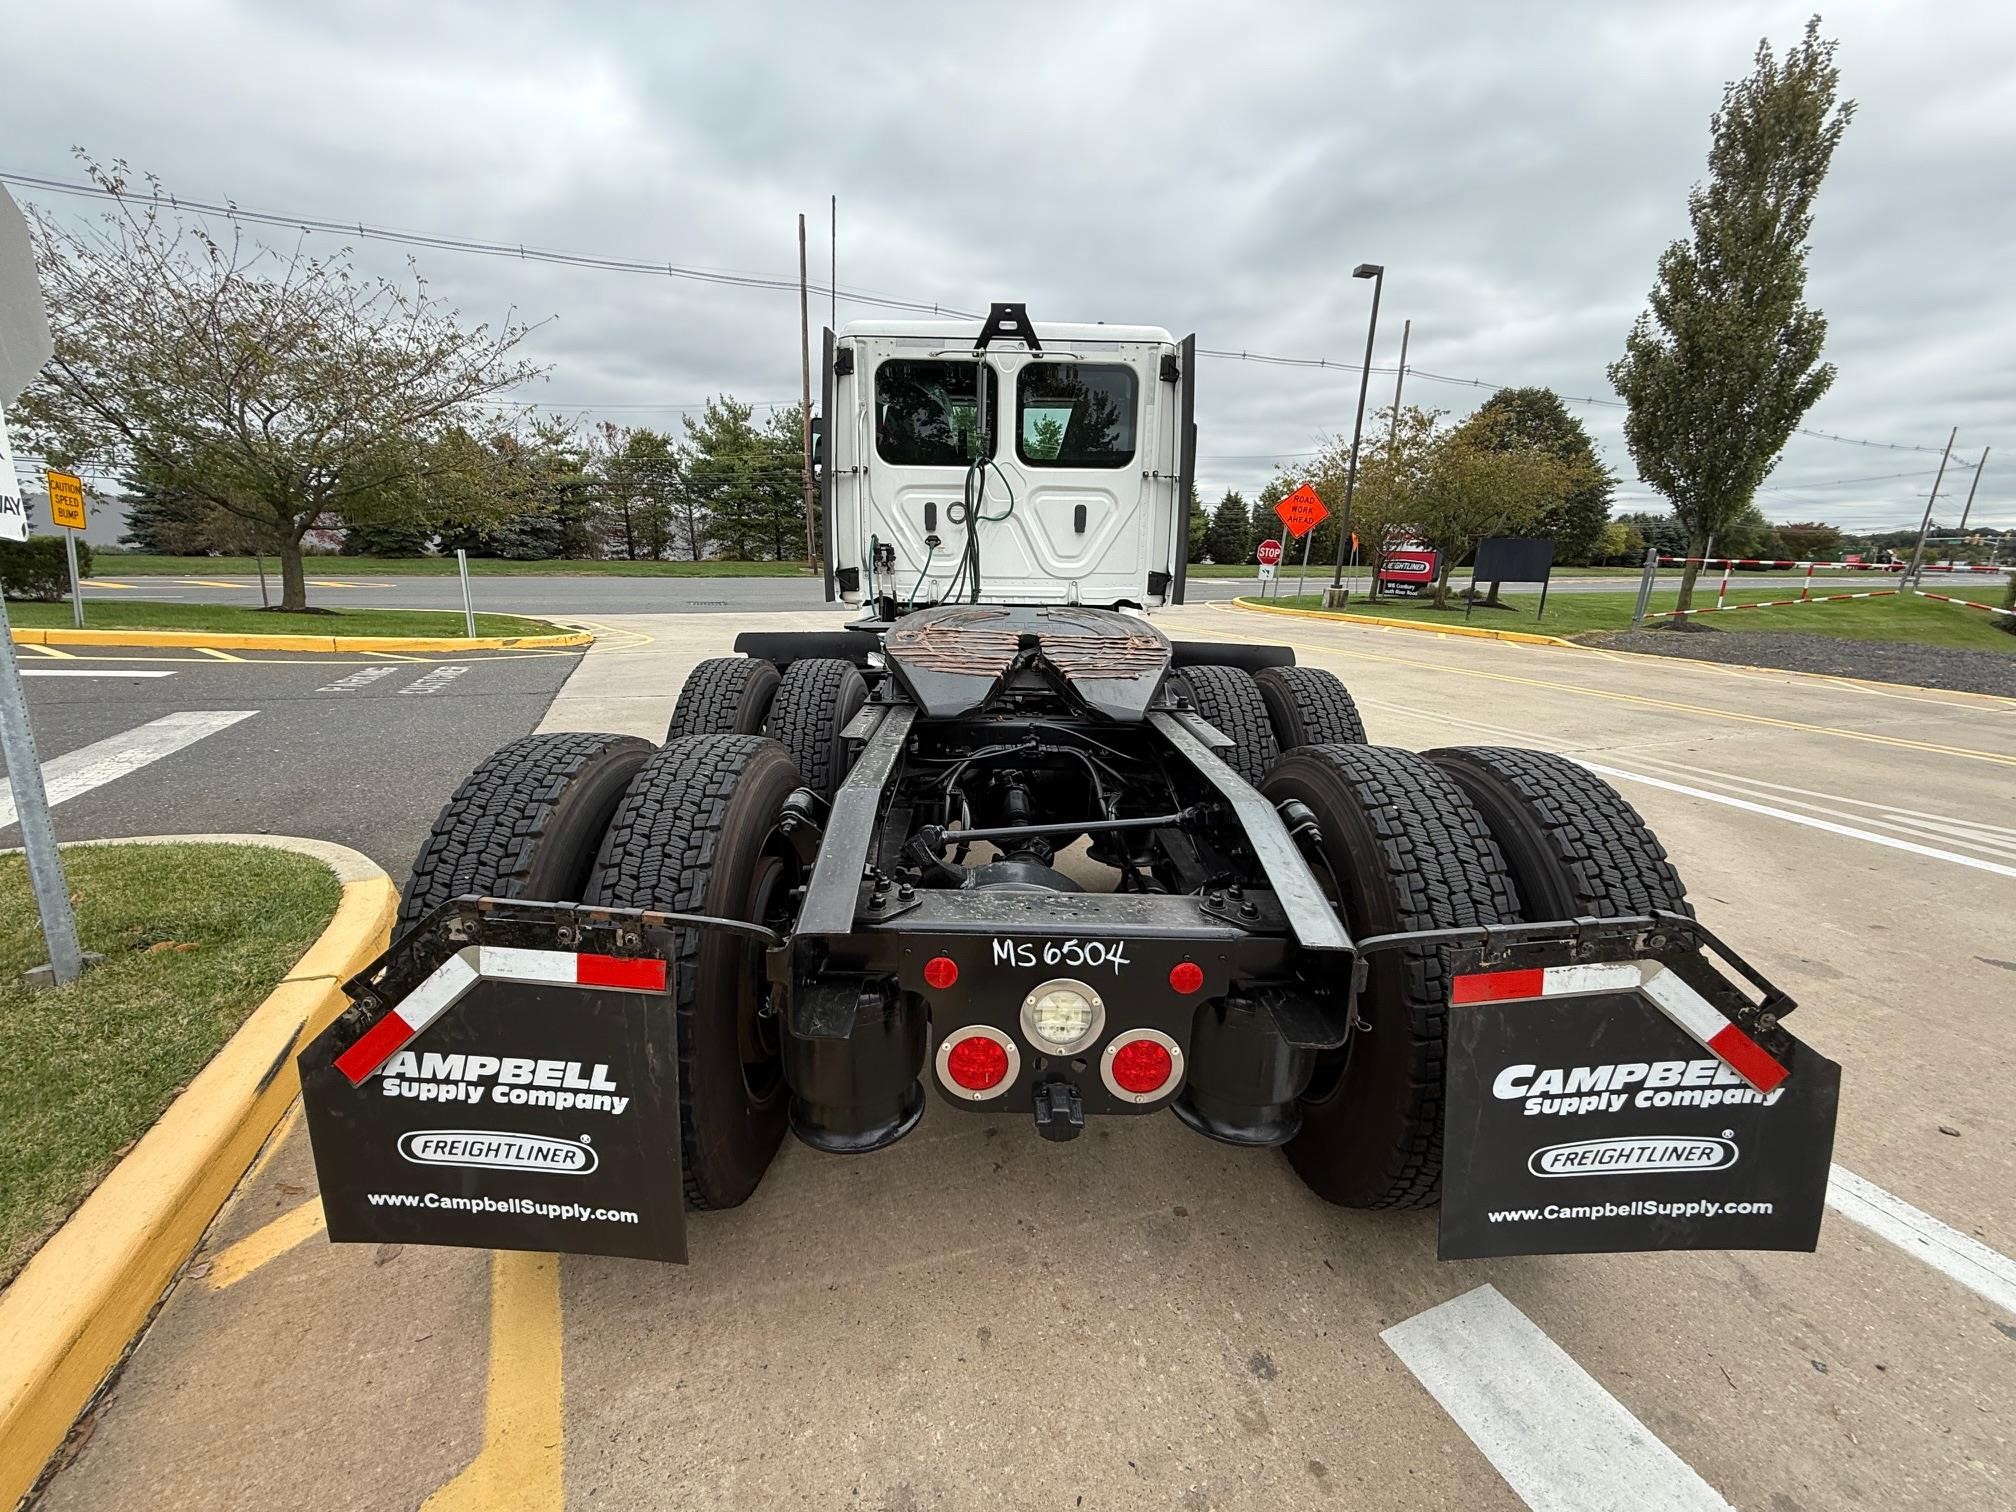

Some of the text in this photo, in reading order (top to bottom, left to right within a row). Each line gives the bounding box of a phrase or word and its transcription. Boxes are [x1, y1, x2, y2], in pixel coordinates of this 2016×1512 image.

[50, 480, 82, 496] CAUTION
[0, 495, 20, 515] AY
[54, 494, 79, 507] SPEED
[1291, 506, 1313, 514] WORK
[1293, 495, 1315, 504] ROAD
[58, 507, 79, 520] BUMP
[1287, 517, 1314, 525] AHEAD
[1259, 547, 1281, 558] STOP
[375, 1050, 617, 1092] AMPBELL
[1491, 1059, 1746, 1101] CAMPBEL
[382, 1078, 630, 1115] Supply Company
[1523, 1085, 1786, 1116] Supply Company
[420, 1139, 577, 1165] FREIGHTLINER
[1549, 1145, 1716, 1169] FREIGHTLINER
[367, 1192, 639, 1224] www.CampbellSupply.com
[1488, 1199, 1774, 1224] www.CampbellSupply.com
